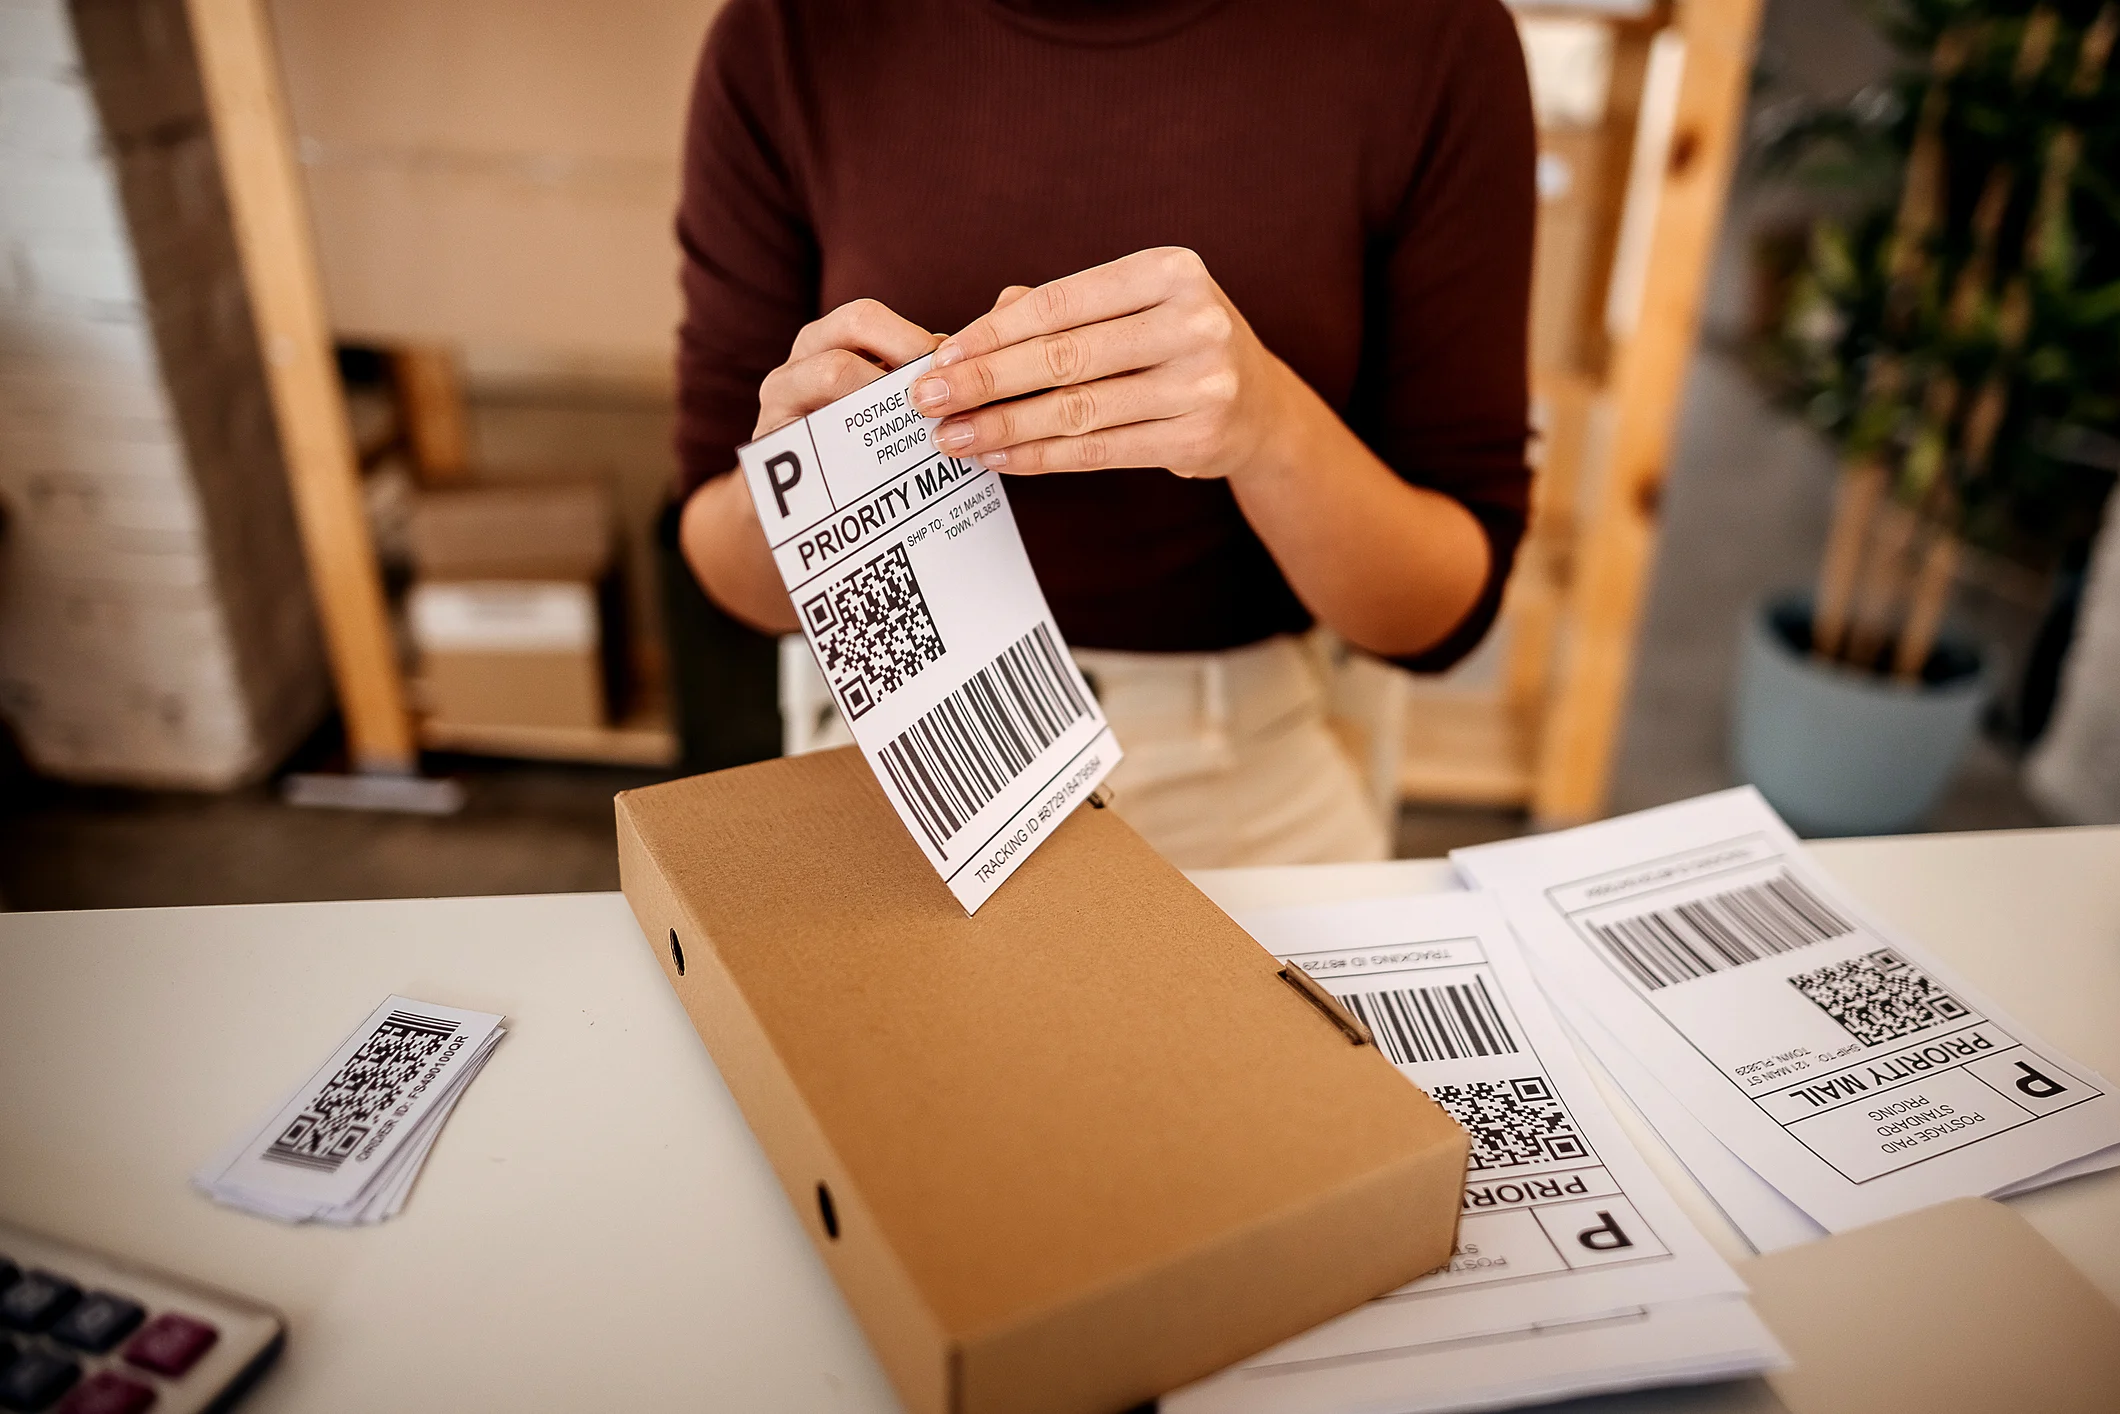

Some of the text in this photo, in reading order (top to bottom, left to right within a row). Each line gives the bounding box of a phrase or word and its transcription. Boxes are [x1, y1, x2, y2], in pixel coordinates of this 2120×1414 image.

[845, 392, 904, 432] POSTAGE
[864, 409, 925, 447] STANDAR
[877, 428, 926, 464] PRICING
[765, 450, 803, 519] P
[798, 455, 972, 570] PRIORITY MAIL
[907, 483, 996, 547] SHIP TO: 121 MAIN ST
[944, 498, 1001, 540] TOWN, PL3829
[974, 829, 1028, 883] TRACKING
[1025, 818, 1039, 834] ID
[1351, 957, 1367, 967] ID
[1371, 949, 1452, 965] TRACKING
[1791, 1060, 1810, 1071] 121
[1837, 1043, 1861, 1057] SHIP
[1747, 1075, 1763, 1086] ST
[1762, 1066, 1792, 1081] MAIN
[1788, 1032, 1994, 1107] PRIORITY MAIL
[2016, 1061, 2068, 1098] P
[355, 1036, 469, 1162] ORDER ID: FS490100QR
[1868, 1094, 1930, 1121] PRICING
[1877, 1104, 1955, 1137] STANDARD
[1881, 1112, 1986, 1154] POSTAGE PAID
[1577, 1210, 1634, 1250] P
